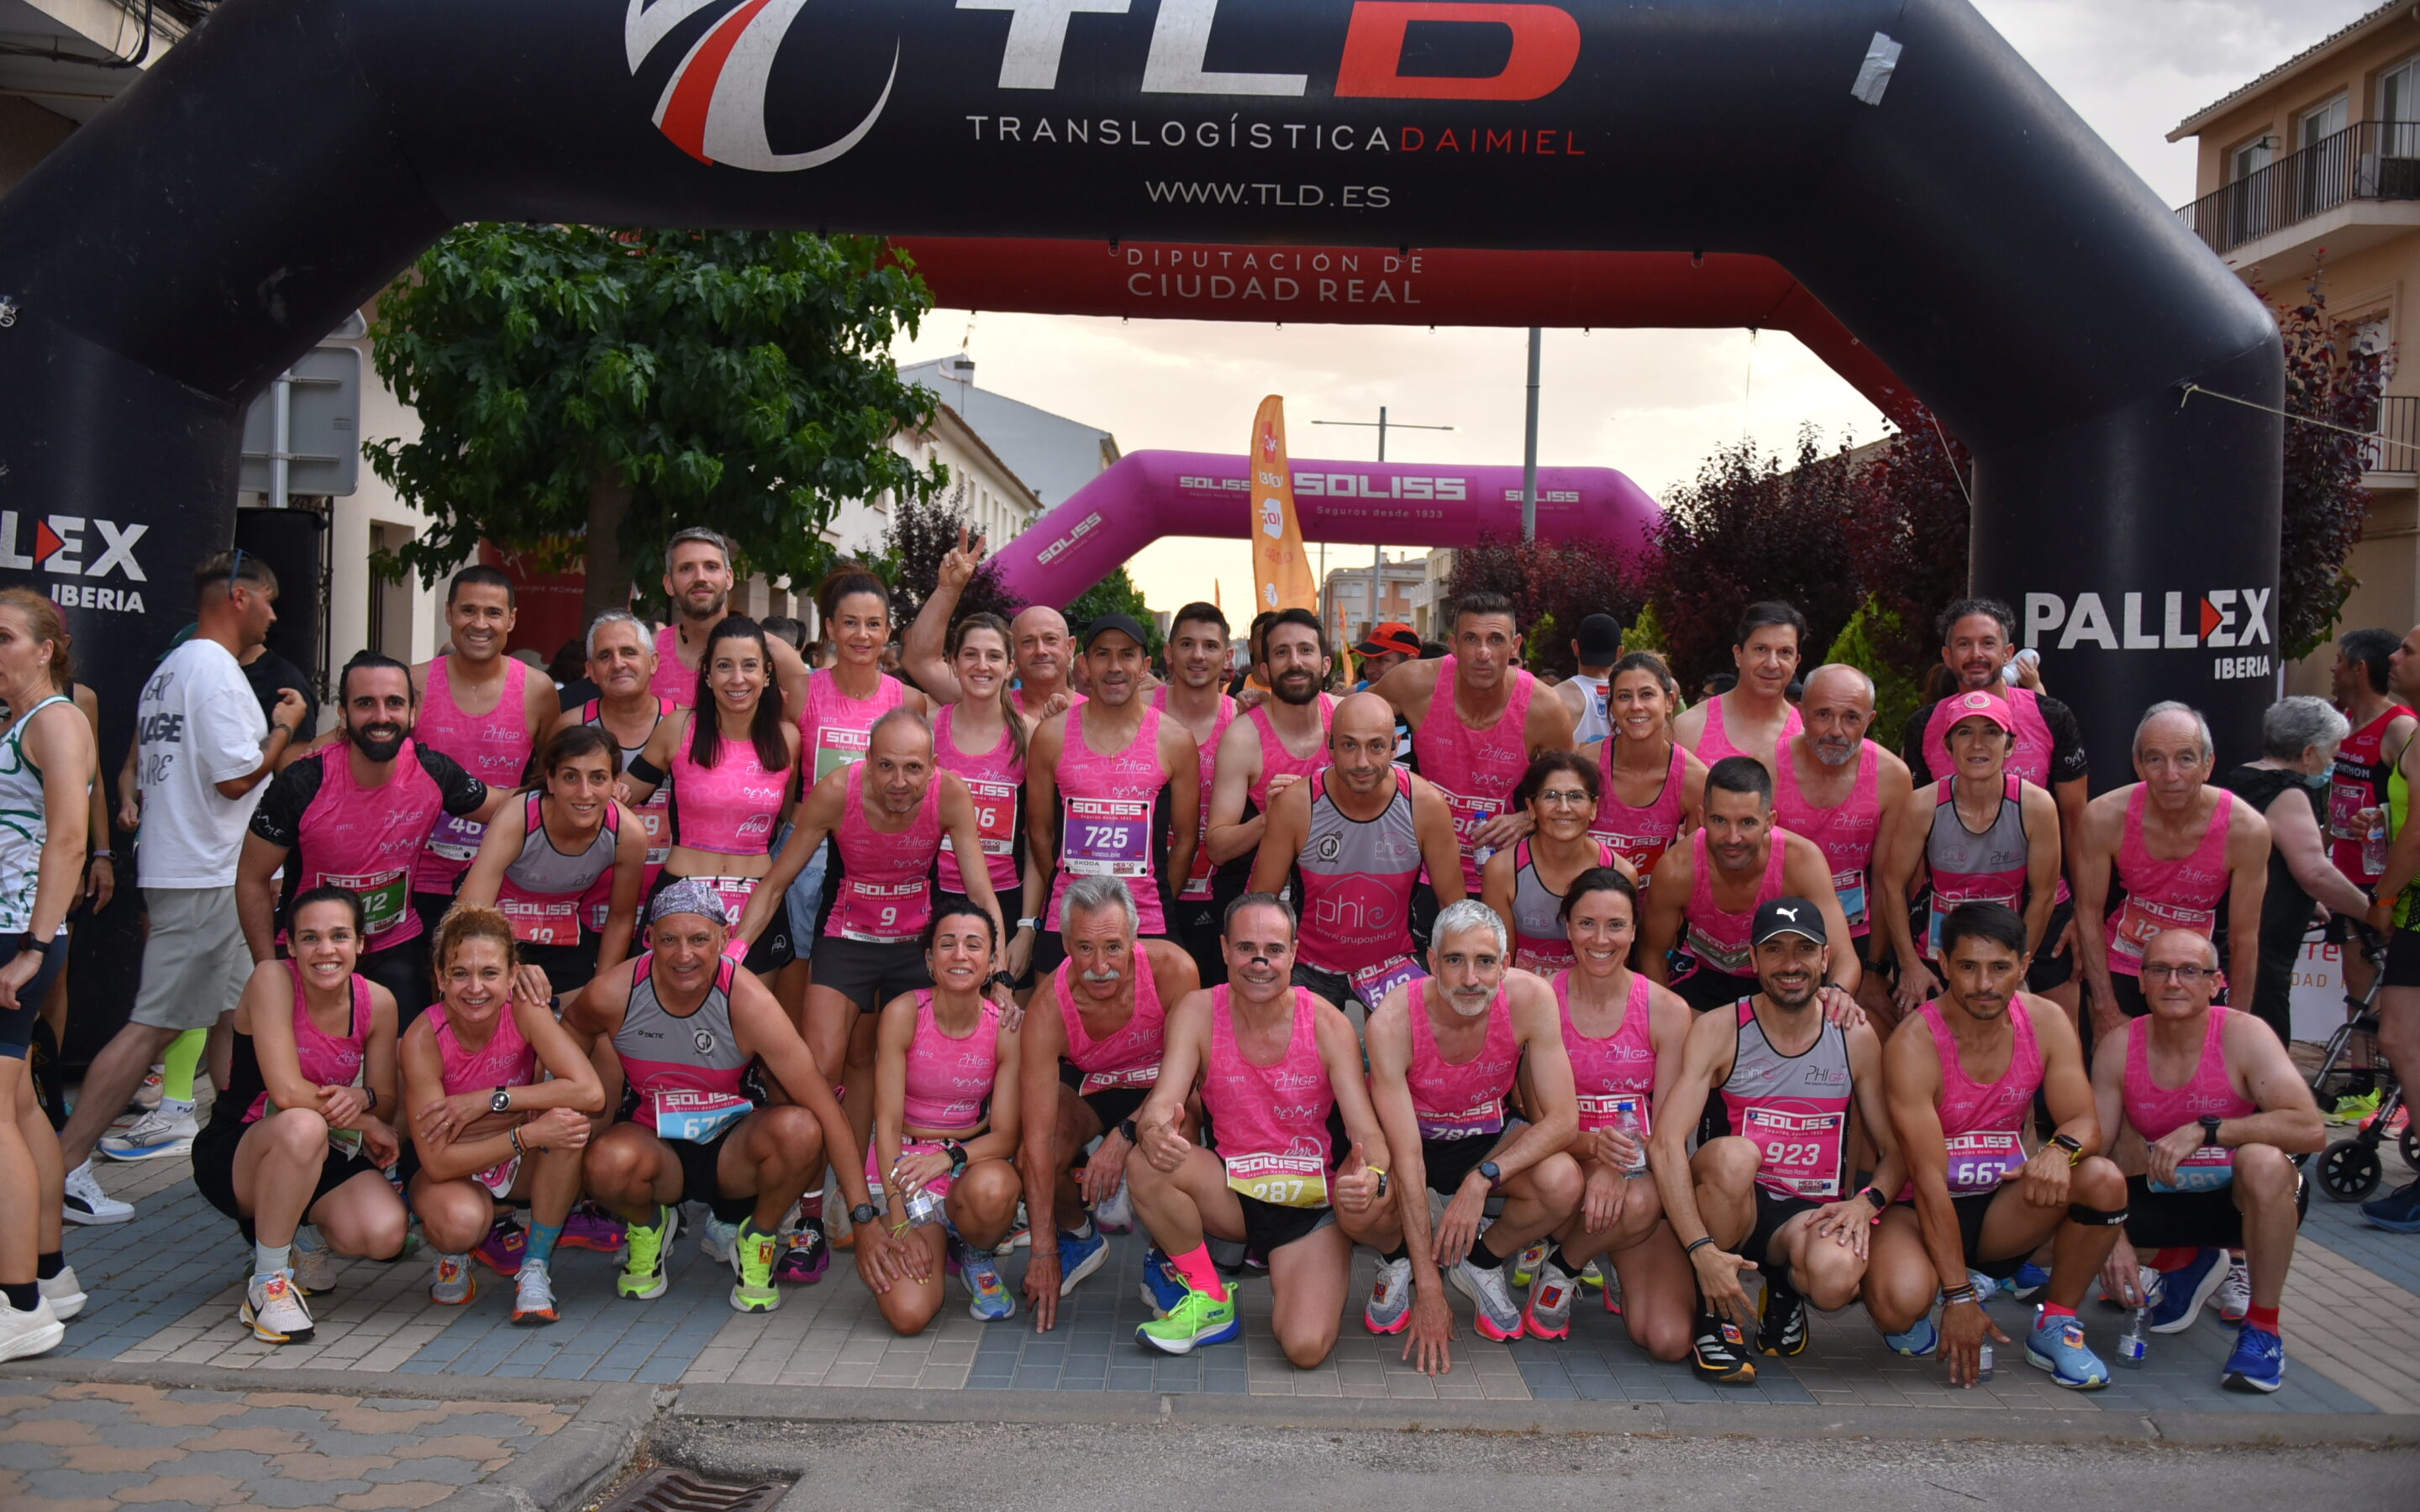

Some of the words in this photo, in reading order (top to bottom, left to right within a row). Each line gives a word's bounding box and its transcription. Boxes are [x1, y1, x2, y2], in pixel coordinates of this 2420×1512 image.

[955, 0, 1582, 101] TLD
[1144, 181, 1392, 210] WWW.TLD.ES
[1126, 248, 1364, 272] DIPUTACIÓN
[1381, 255, 1424, 276] DE
[1126, 273, 1300, 304] CIUDAD
[1319, 276, 1422, 306] REAL
[1294, 472, 1466, 501] SOLISS
[1317, 506, 1368, 518] Seguros
[1373, 509, 1409, 518] desde
[1416, 509, 1444, 519] 1933
[1036, 511, 1103, 566] SOLISS
[50, 583, 146, 614] IBERIA
[2024, 587, 2271, 650] PALLEX
[2213, 654, 2270, 681] IBERIA
[1072, 802, 1142, 816] SOLISS
[1084, 826, 1129, 848] 725
[326, 871, 401, 888] SOLISS
[853, 881, 923, 896] SOLISS
[504, 903, 572, 916] SOLISS
[880, 906, 897, 927] 9
[2133, 896, 2207, 922] SOLISS
[1605, 1043, 1648, 1059] PHIGP
[1274, 1071, 1318, 1087] PHIGP
[2186, 1094, 2227, 1110] PHIGP
[1753, 1113, 1833, 1131] SOLISS
[1765, 1142, 1820, 1166] 923
[1236, 1158, 1315, 1173] SOLISS
[1252, 1180, 1304, 1203] 287
